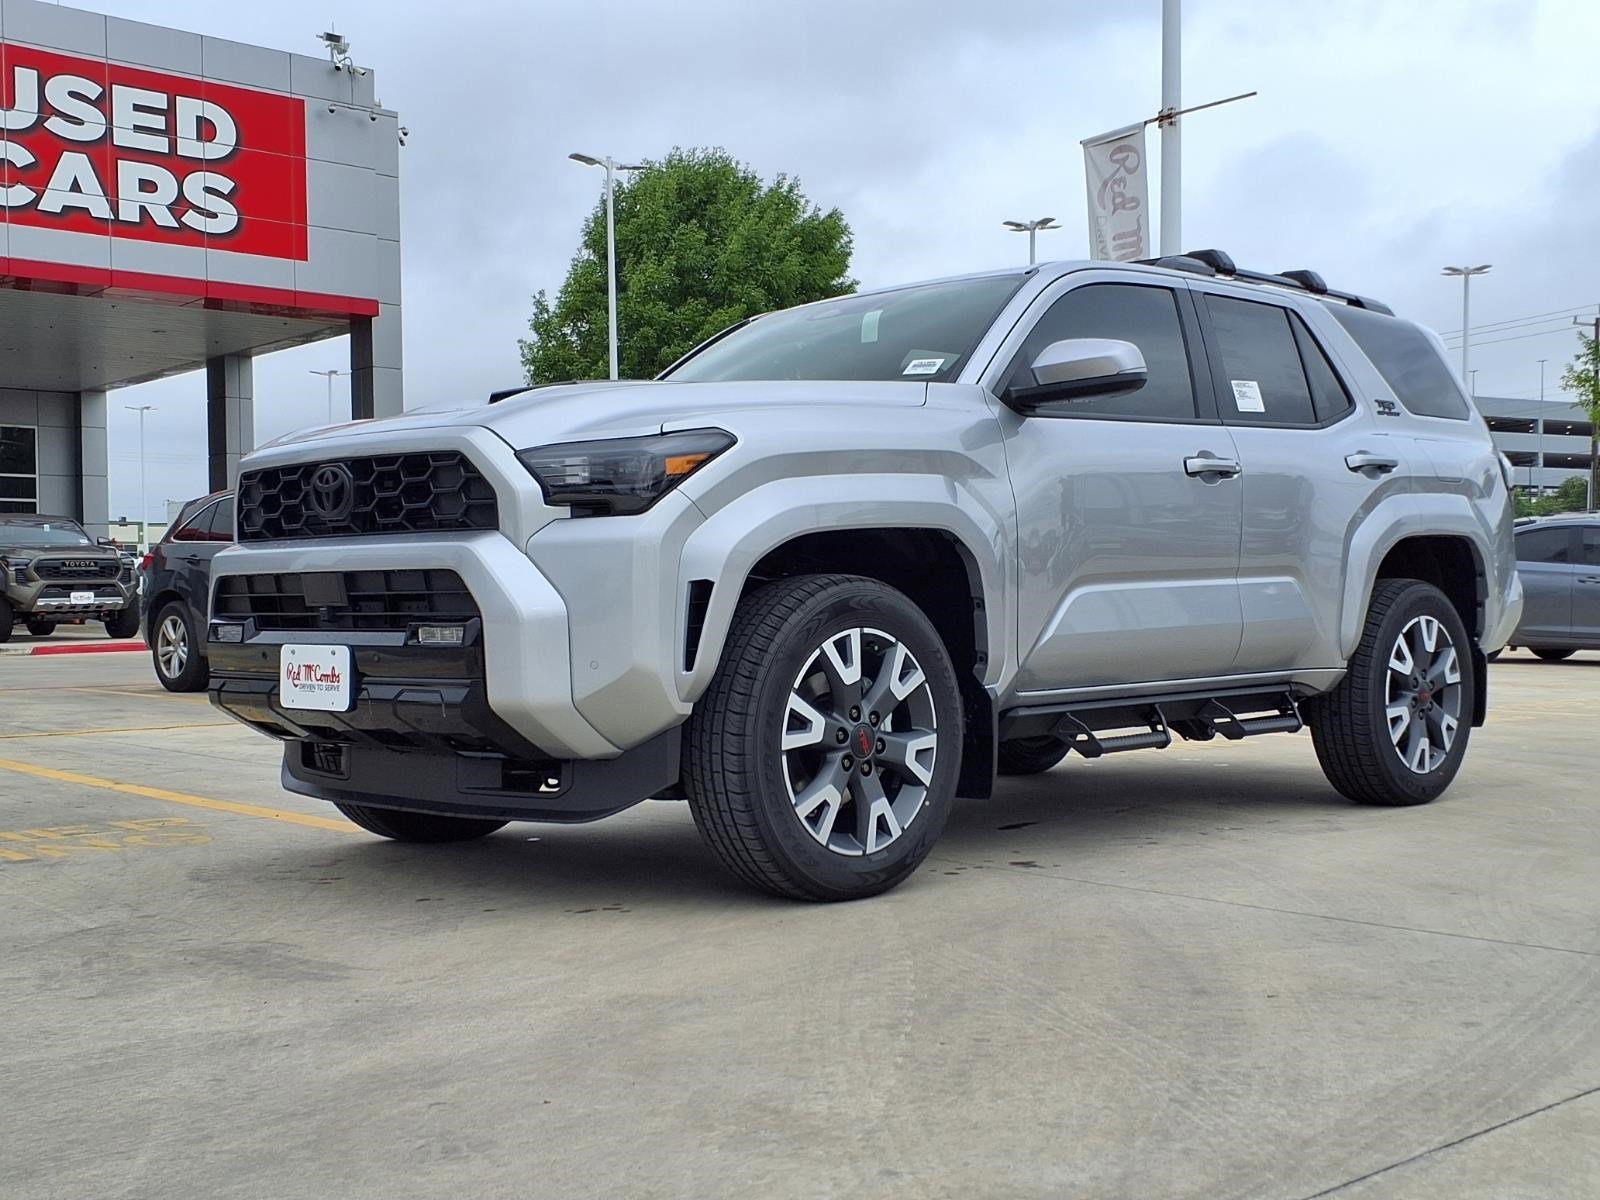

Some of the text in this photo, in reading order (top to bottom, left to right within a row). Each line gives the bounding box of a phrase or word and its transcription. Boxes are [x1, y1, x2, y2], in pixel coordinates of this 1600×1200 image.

[0, 66, 237, 160] USED
[1097, 144, 1141, 217] Red
[287, 662, 341, 688] Red McCombs
